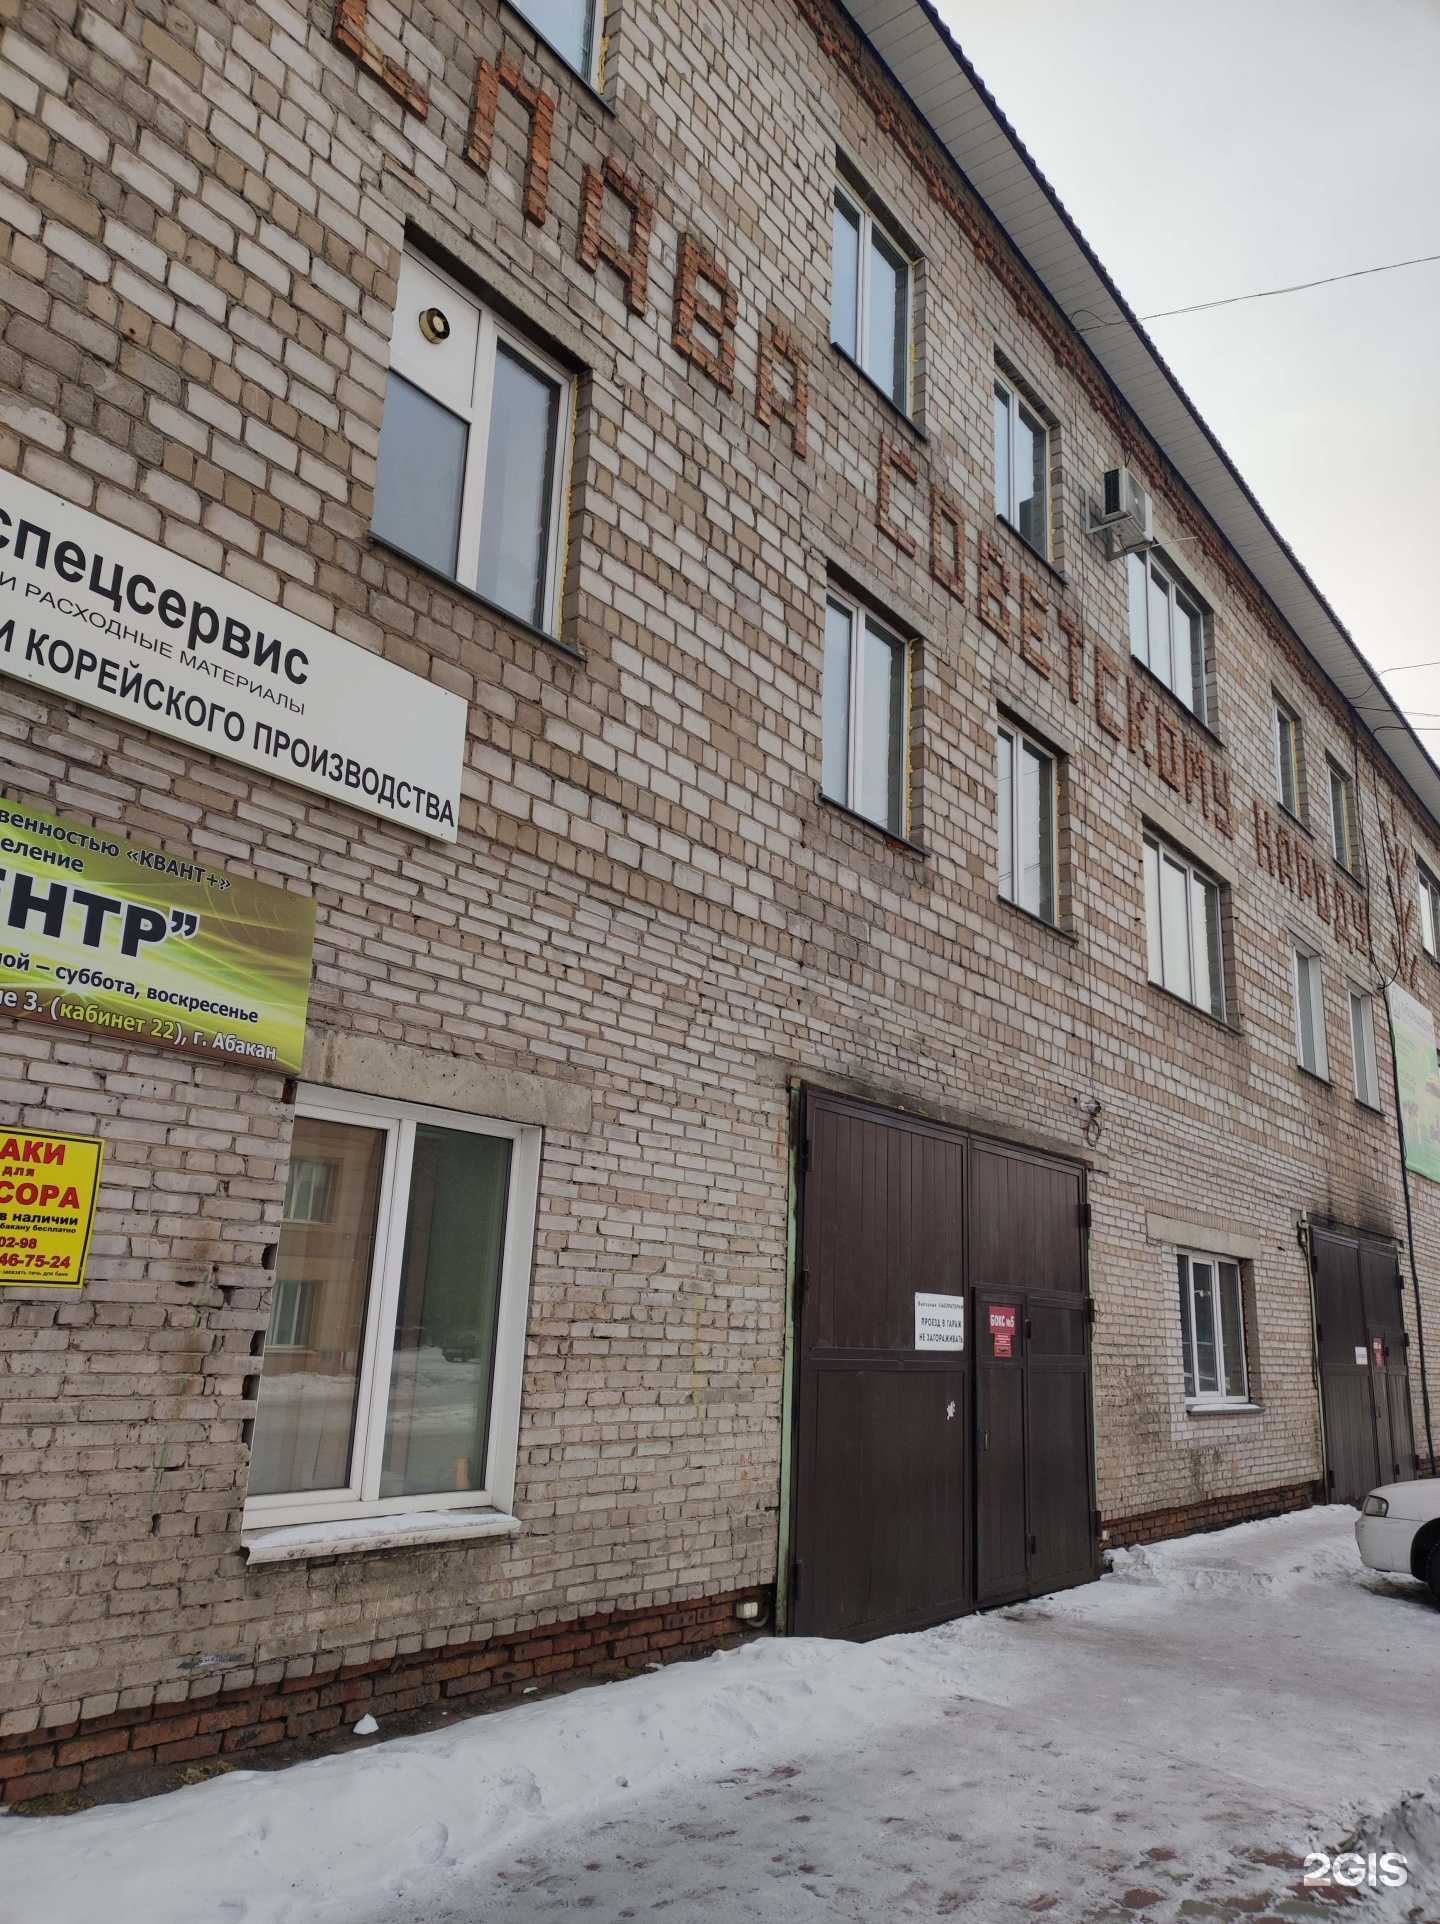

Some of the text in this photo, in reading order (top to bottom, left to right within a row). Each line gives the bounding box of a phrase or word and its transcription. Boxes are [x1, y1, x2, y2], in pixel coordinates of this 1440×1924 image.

[25, 582, 173, 659] РАСХОДНЫЕ
[180, 650, 305, 715] МАТЕРИАЛЫ
[877, 432, 1233, 840] СОВЕТСКОМУ
[1253, 801, 1369, 957] НАРОДУ
[25, 628, 245, 742] КОРЕЙСКОГО
[253, 721, 455, 828] ПРОИЗВОДСТВА
[0, 837, 84, 873] еление
[127, 849, 231, 890] «КВАНТ+»
[0, 868, 198, 957] НТР”
[55, 965, 140, 999] суббота,
[147, 987, 259, 1023] воскресенье
[23, 991, 42, 1012] 3.
[50, 995, 146, 1034] (кабинет
[151, 1018, 187, 1046] 22),
[192, 1032, 208, 1047] г.
[212, 1031, 277, 1061] Абакан
[12, 1213, 78, 1225] наличии
[32, 1224, 76, 1233] бесплатно
[919, 1332, 963, 1344] НЕ ЗАГОРАЖИВАТЬ
[921, 1317, 941, 1328] ПРОЕЗД
[946, 1319, 962, 1329] ГАРАЖ
[990, 1314, 1005, 1328] БОКС
